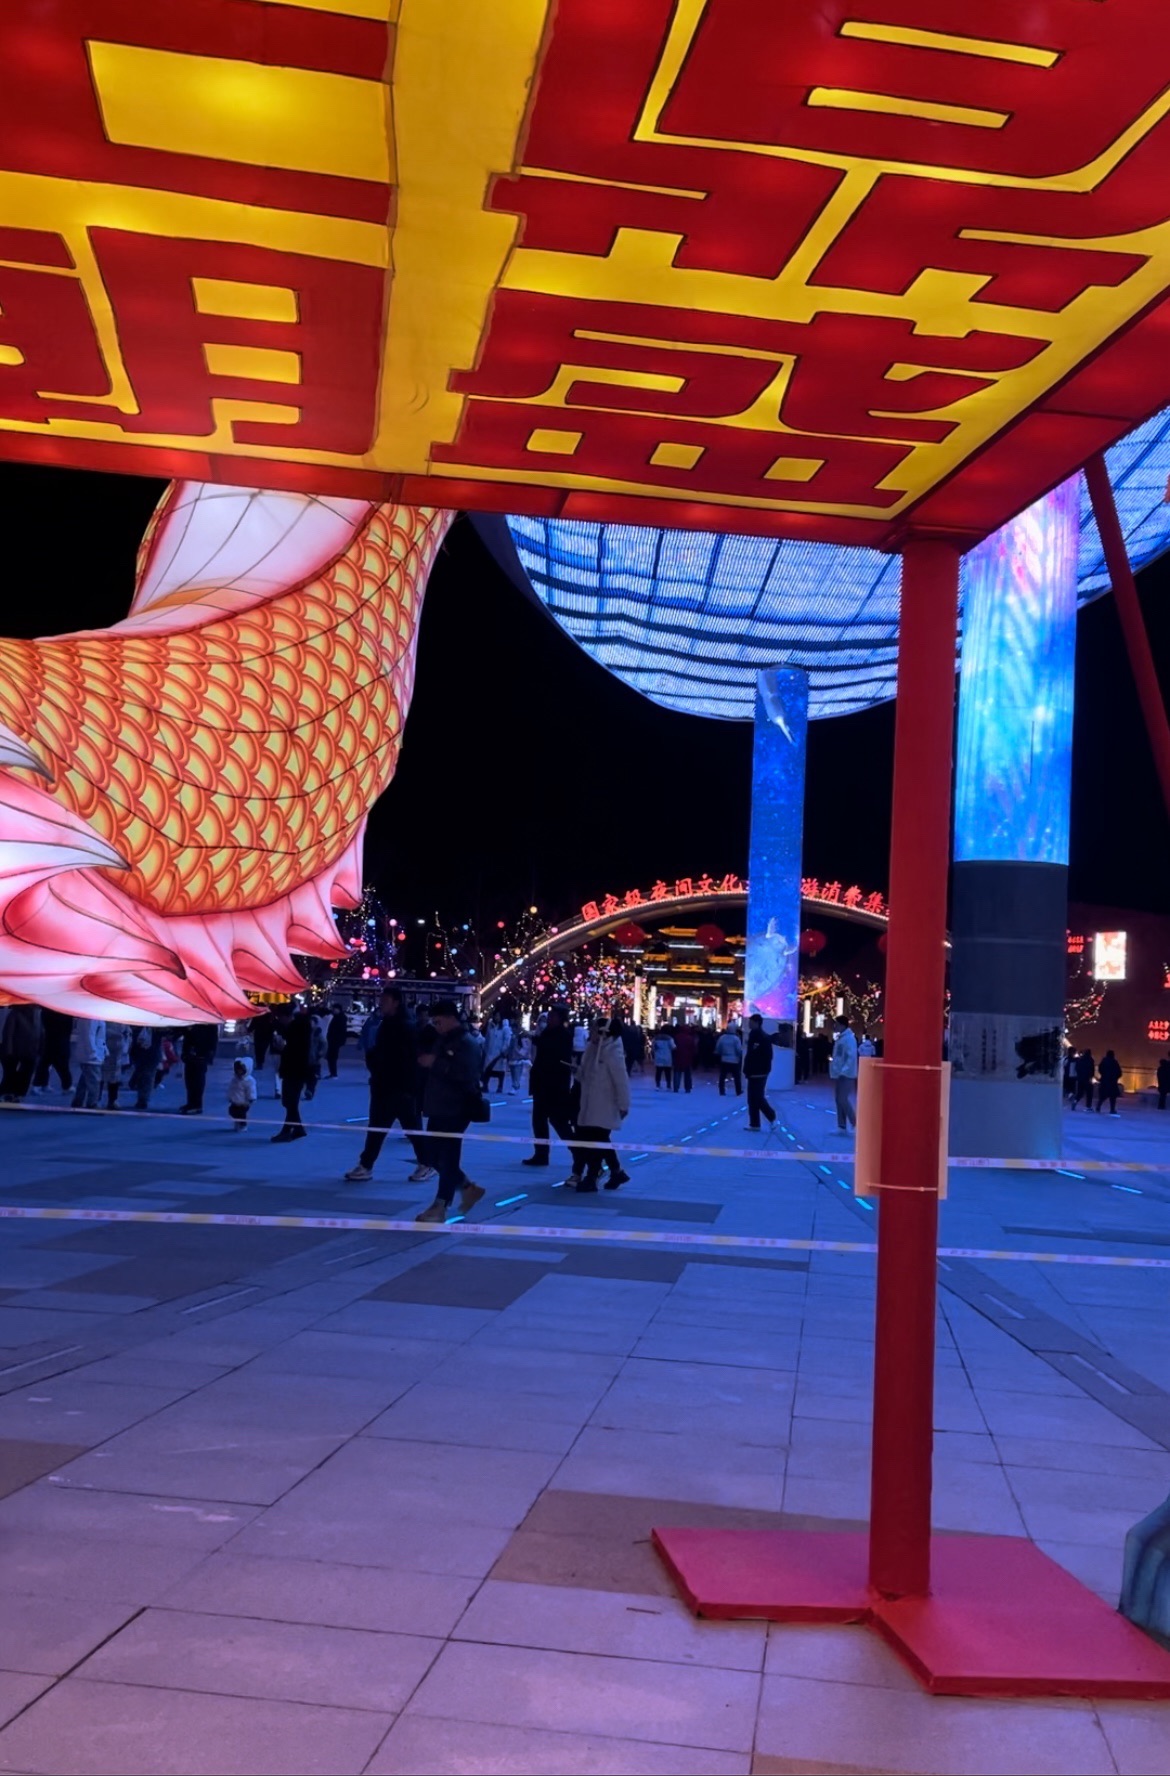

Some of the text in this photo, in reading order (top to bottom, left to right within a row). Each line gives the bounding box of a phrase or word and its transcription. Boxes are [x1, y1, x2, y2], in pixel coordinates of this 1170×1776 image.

[581, 873, 890, 921] 国家级夜间文化游消费集
